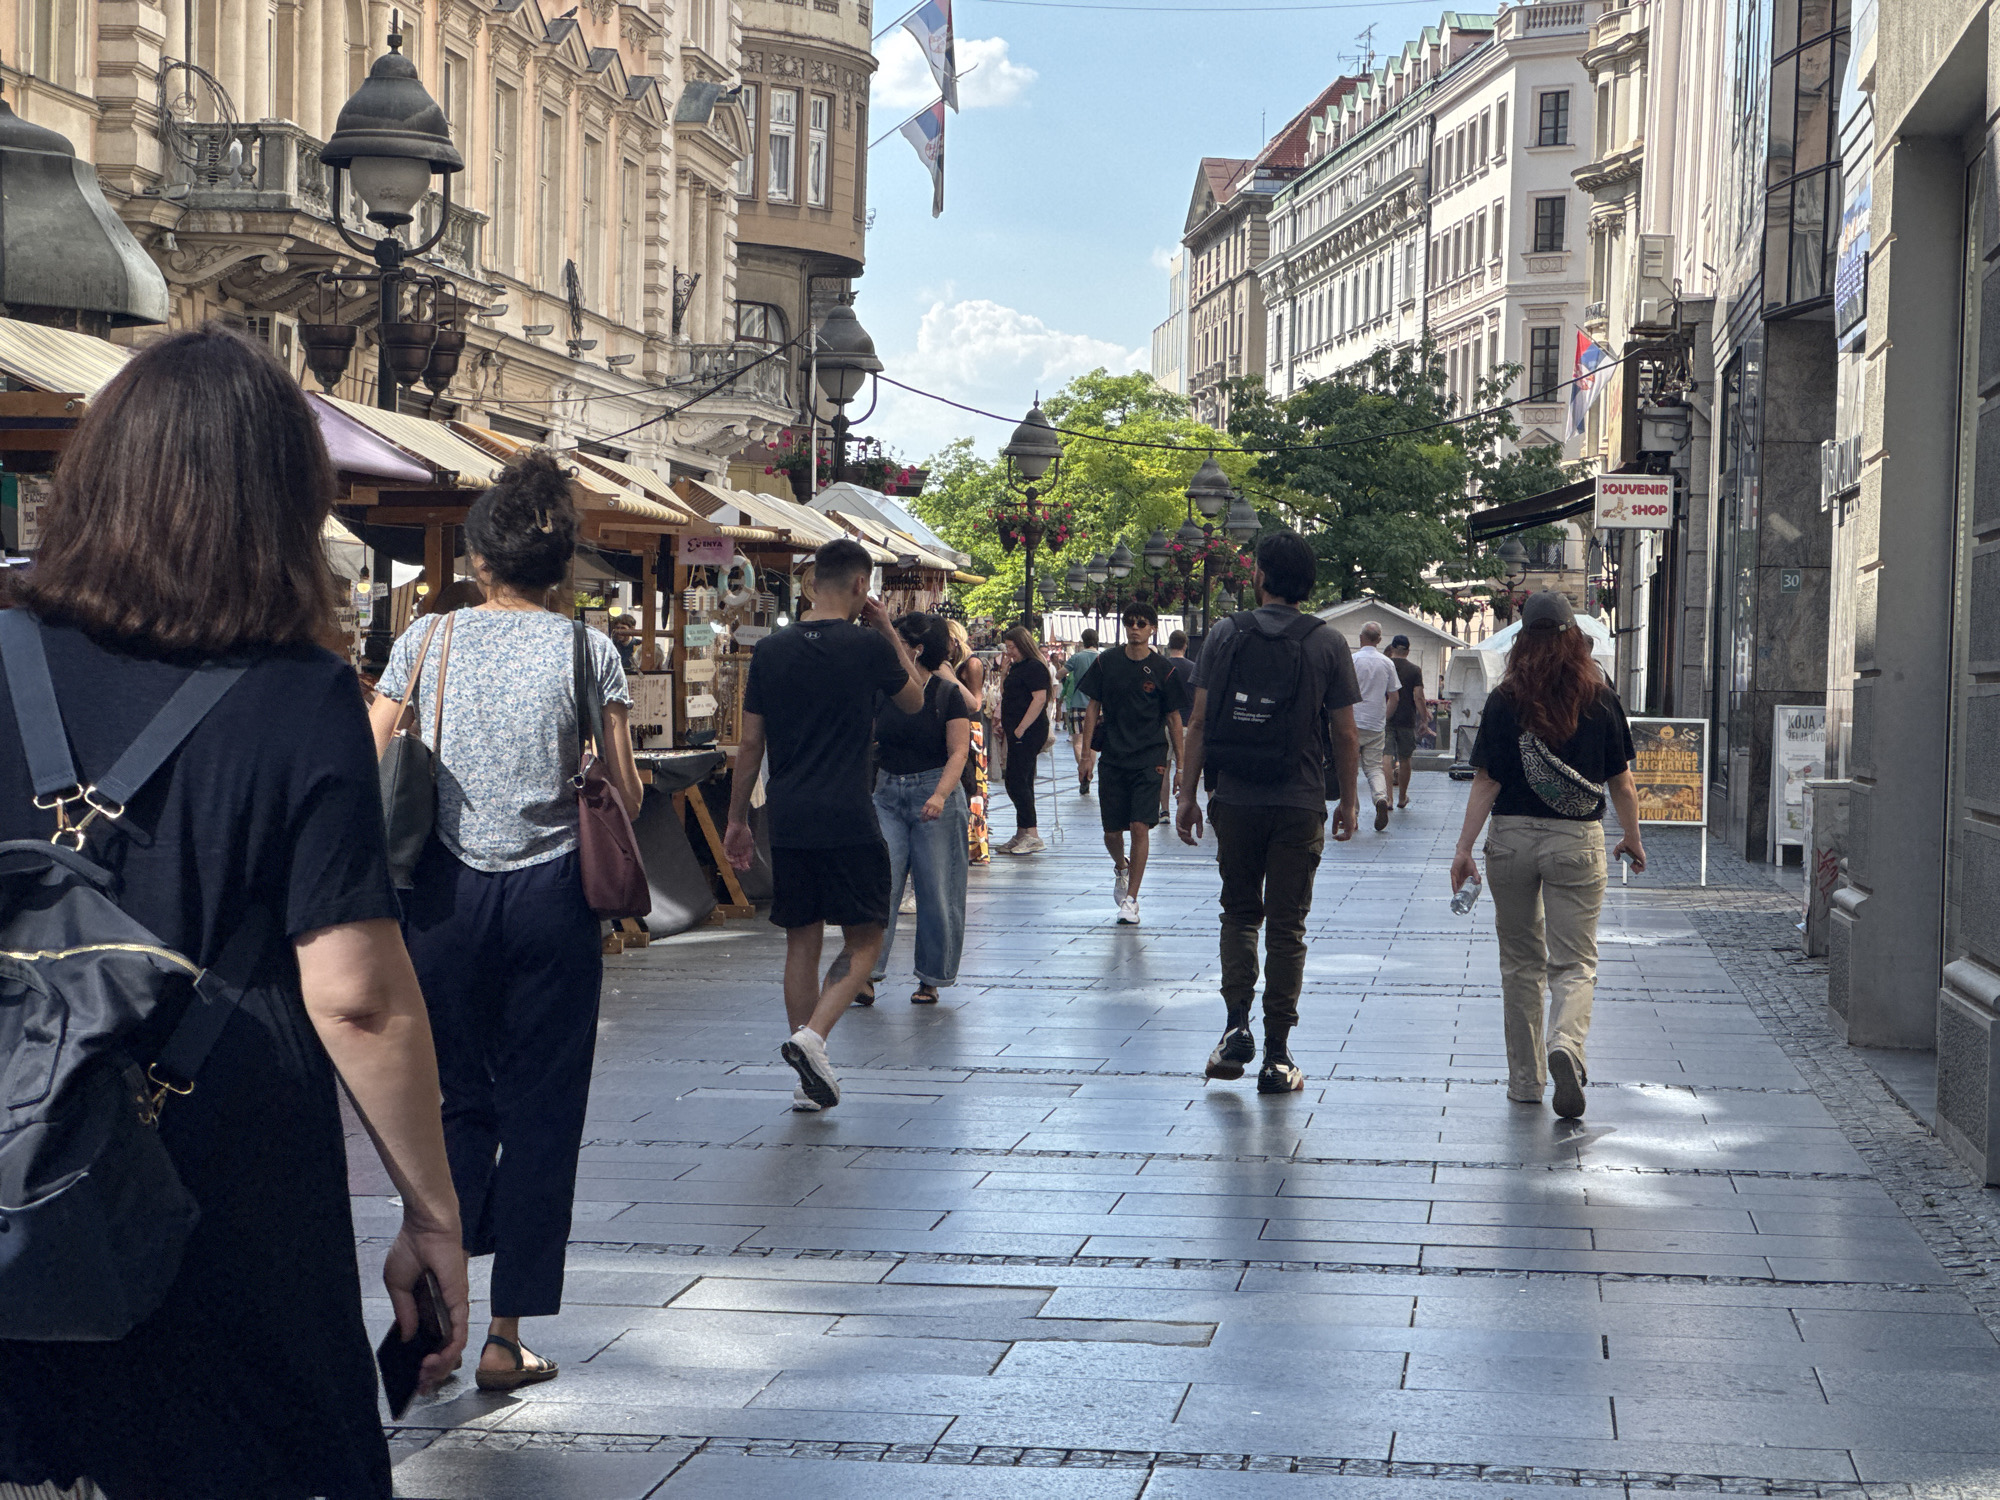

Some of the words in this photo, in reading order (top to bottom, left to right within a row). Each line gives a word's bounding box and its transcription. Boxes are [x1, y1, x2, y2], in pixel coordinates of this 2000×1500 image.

[1602, 483, 1669, 496] SOUVENIR
[1631, 504, 1668, 516] SHOP
[1783, 574, 1800, 588] 30
[1788, 715, 1815, 730] KOJA
[1637, 760, 1698, 771] EXCHANGE
[1639, 808, 1669, 820] TKUP
[1671, 808, 1702, 821] ZLATA
